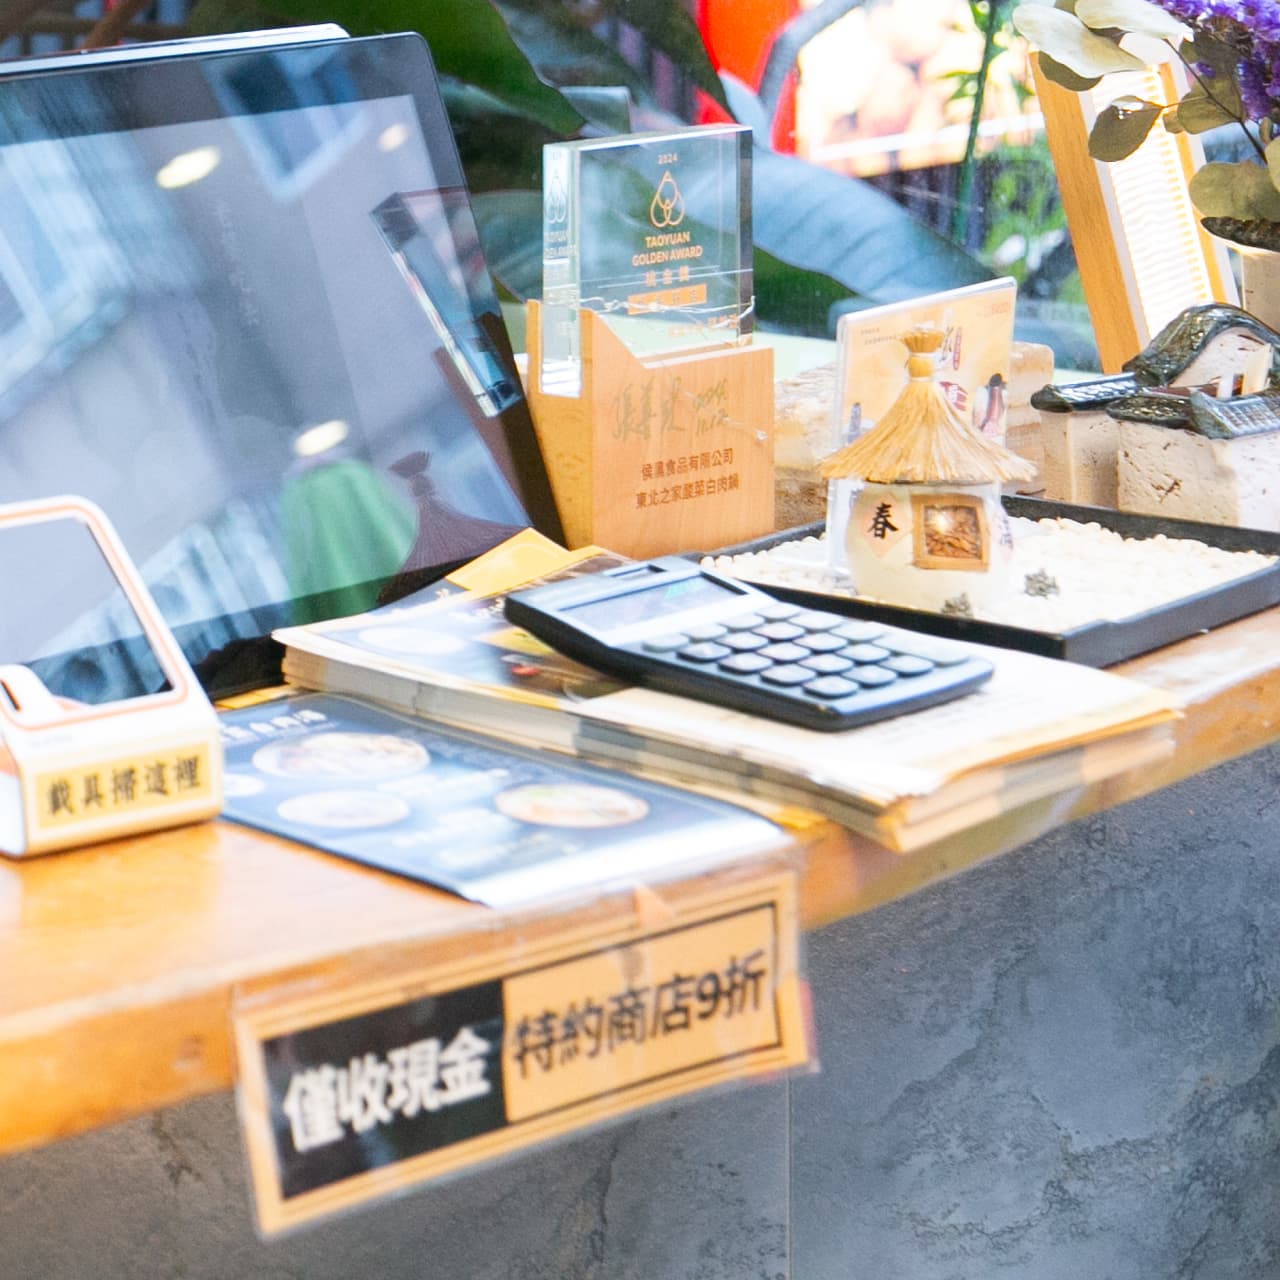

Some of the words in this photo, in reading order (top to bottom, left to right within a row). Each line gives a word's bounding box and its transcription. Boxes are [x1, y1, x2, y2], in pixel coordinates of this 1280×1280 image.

[644, 231, 691, 248] TAOYUAN
[631, 251, 669, 267] GOLDEN
[669, 245, 704, 262] AWARD
[867, 503, 899, 540] 春
[283, 1025, 493, 1154] 僅收現金
[511, 948, 768, 1079] 特約商店9折
